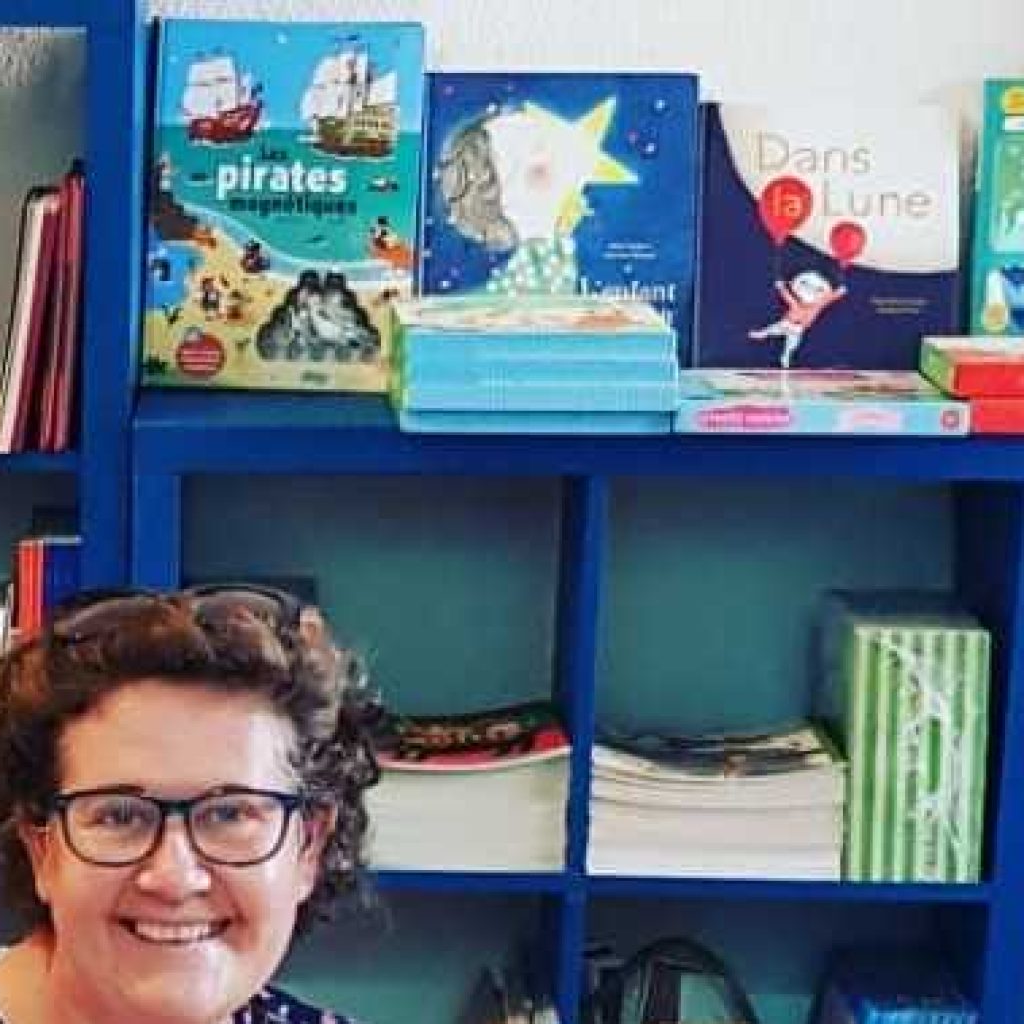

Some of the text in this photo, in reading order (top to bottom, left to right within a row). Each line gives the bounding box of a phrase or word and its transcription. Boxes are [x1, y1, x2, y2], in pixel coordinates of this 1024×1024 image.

[756, 130, 872, 174] Dans
[215, 156, 347, 198] pirates
[824, 179, 932, 217] Lune
